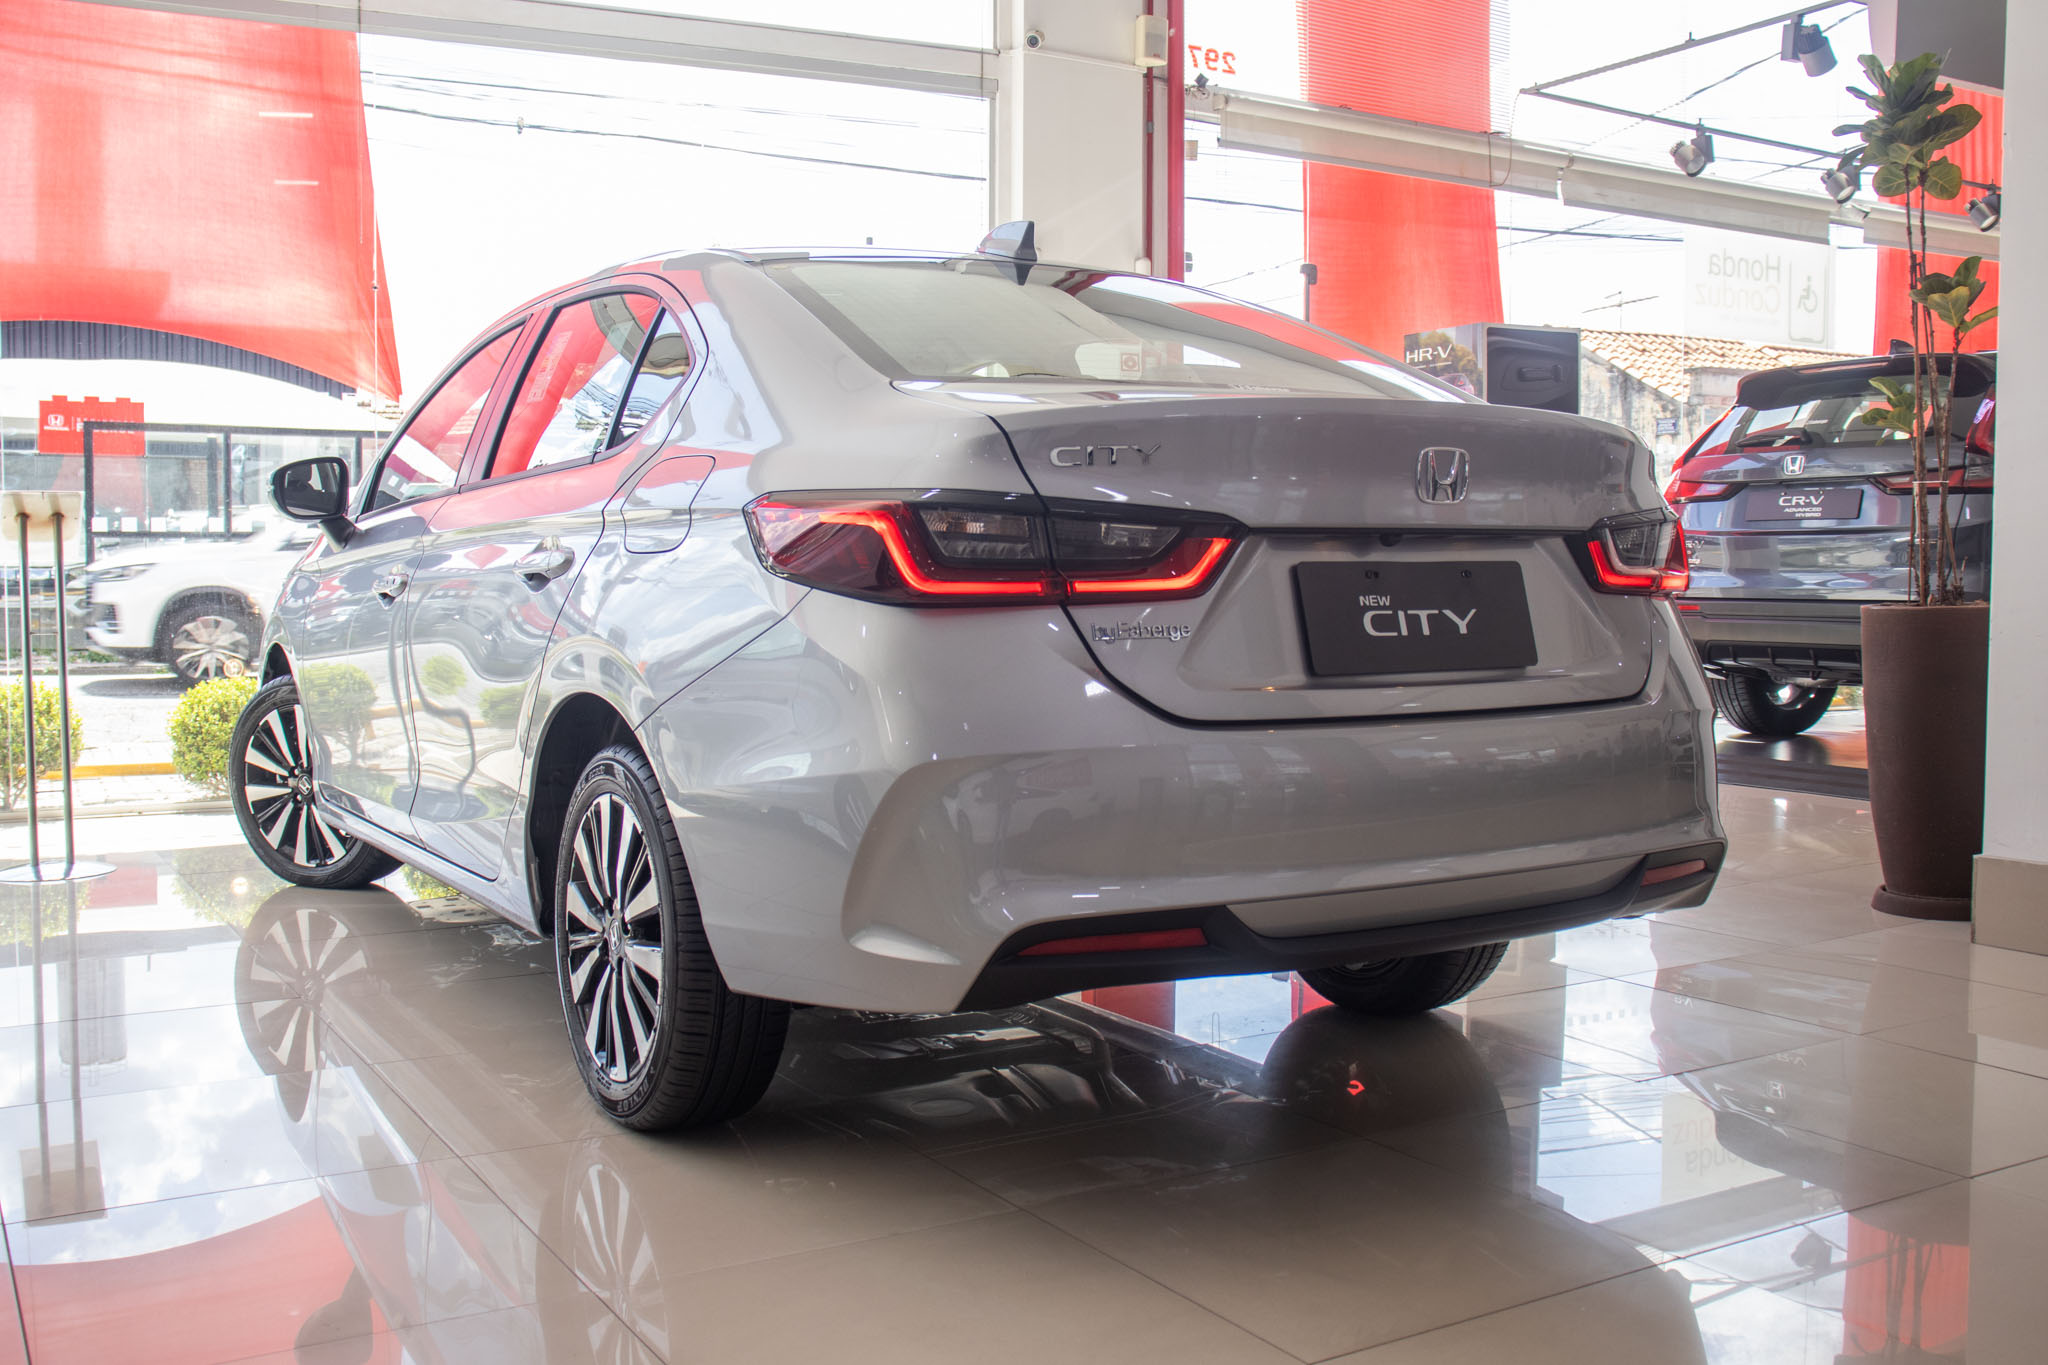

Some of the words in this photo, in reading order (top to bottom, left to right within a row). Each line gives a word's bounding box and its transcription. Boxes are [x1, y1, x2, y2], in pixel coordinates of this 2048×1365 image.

[1406, 344, 1453, 364] HR-V
[1050, 445, 1160, 467] CITY
[1778, 495, 1824, 506] CR-V
[1359, 594, 1391, 607] NEW
[1362, 608, 1478, 637] CITY
